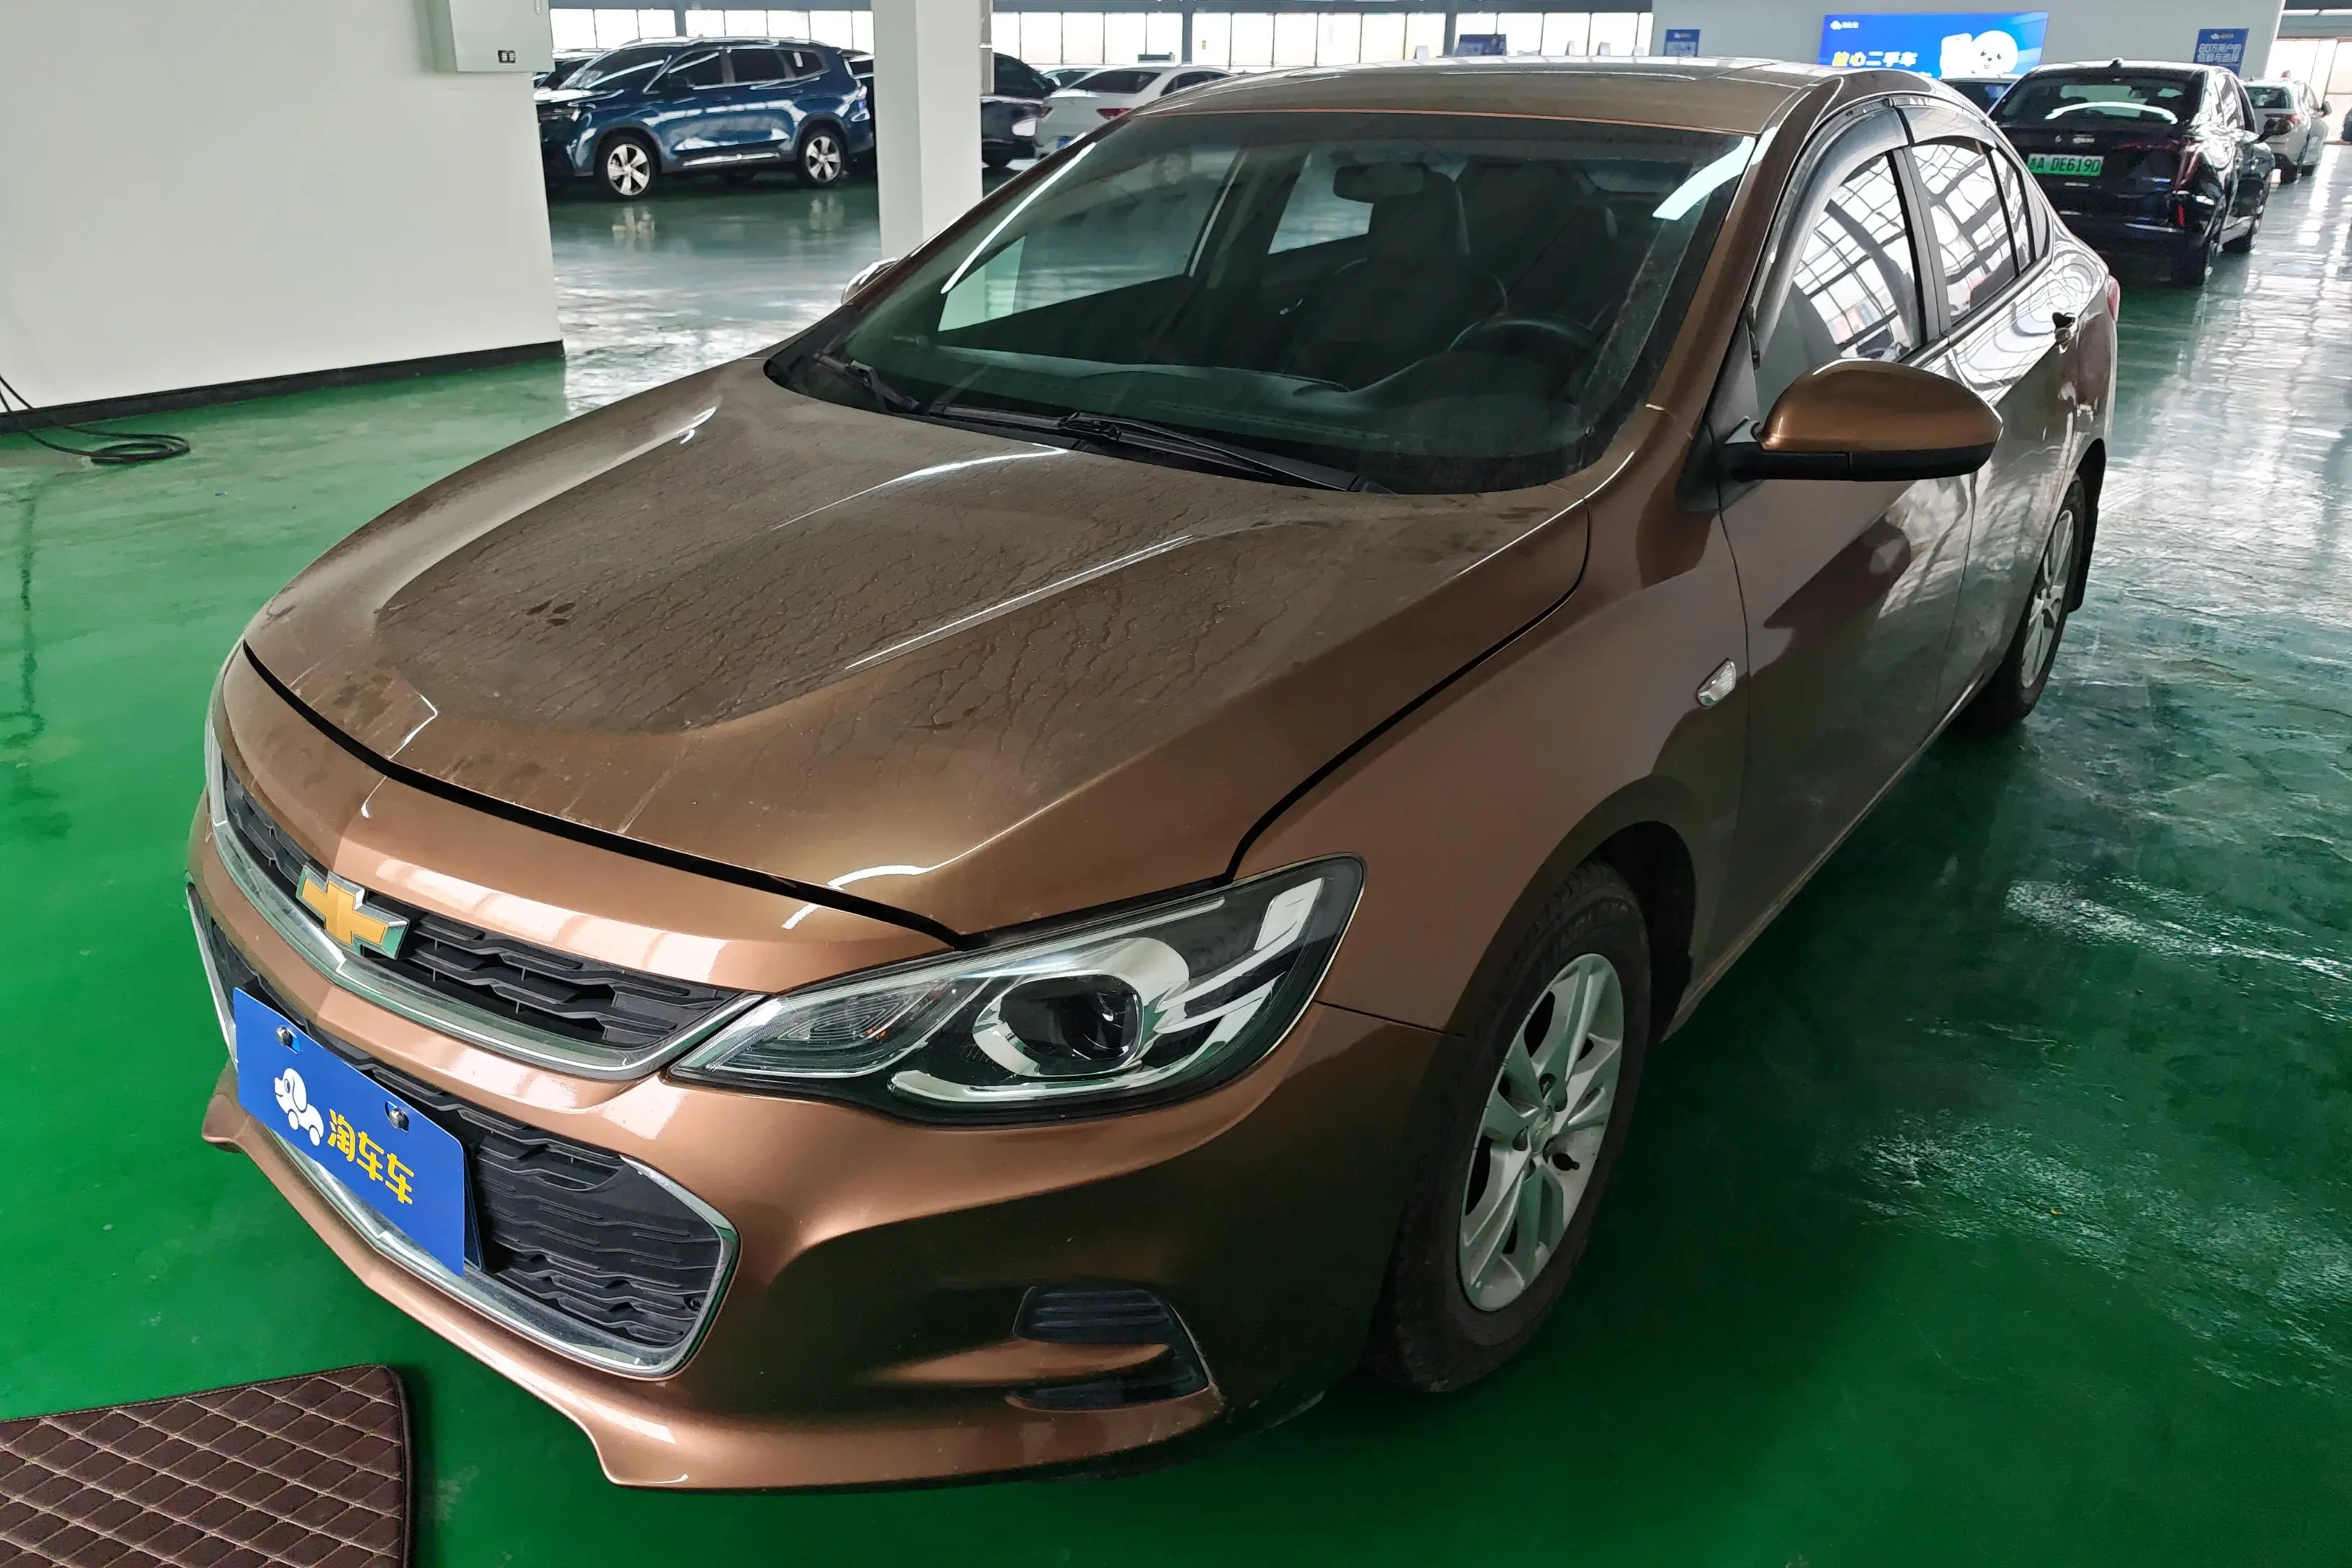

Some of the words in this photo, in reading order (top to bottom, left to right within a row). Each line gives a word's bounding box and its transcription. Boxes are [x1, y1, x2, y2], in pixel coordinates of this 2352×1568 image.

[2051, 157, 2101, 173] DE6190
[328, 1108, 415, 1205] 淘车车
